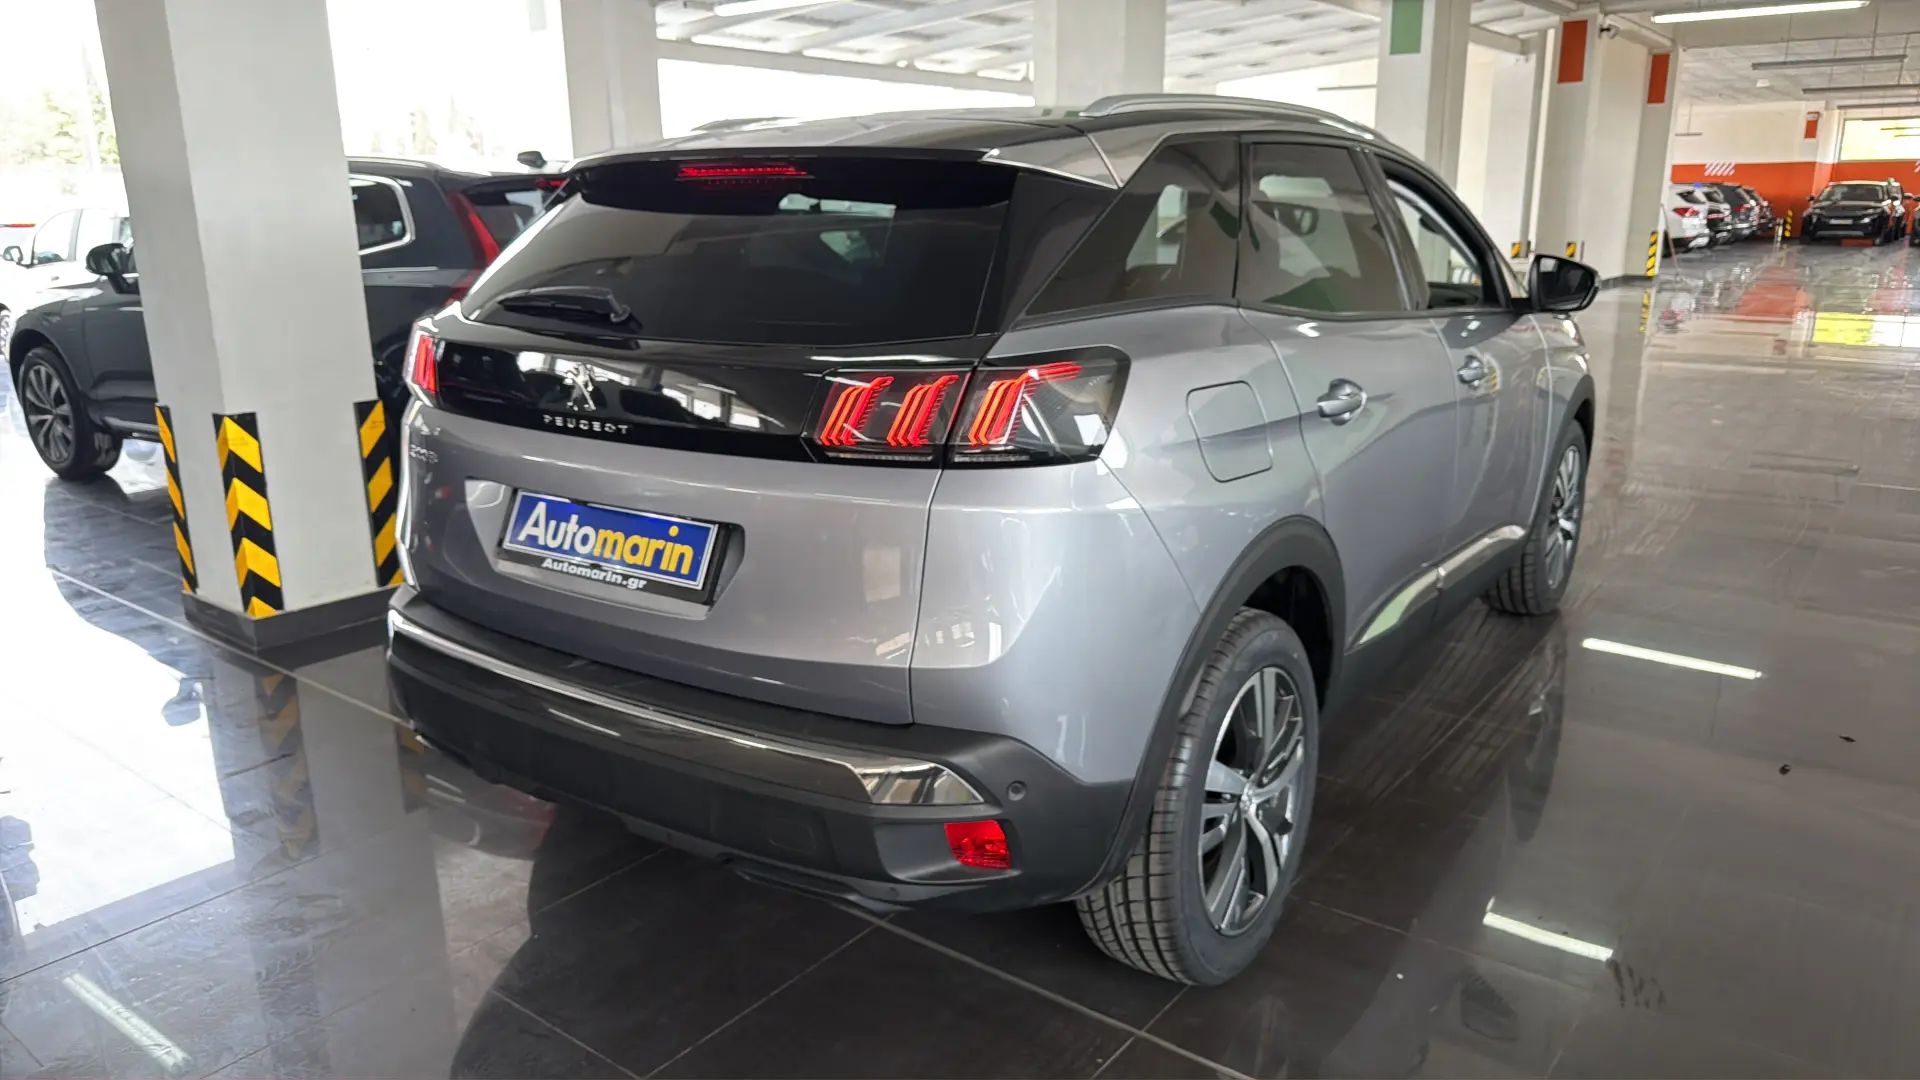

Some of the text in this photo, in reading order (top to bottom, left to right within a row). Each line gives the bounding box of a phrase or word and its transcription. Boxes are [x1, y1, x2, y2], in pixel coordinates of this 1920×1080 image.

[542, 414, 628, 434] PEUGEOT
[517, 501, 694, 575] Automarin
[541, 558, 647, 590] Automarin.gr
